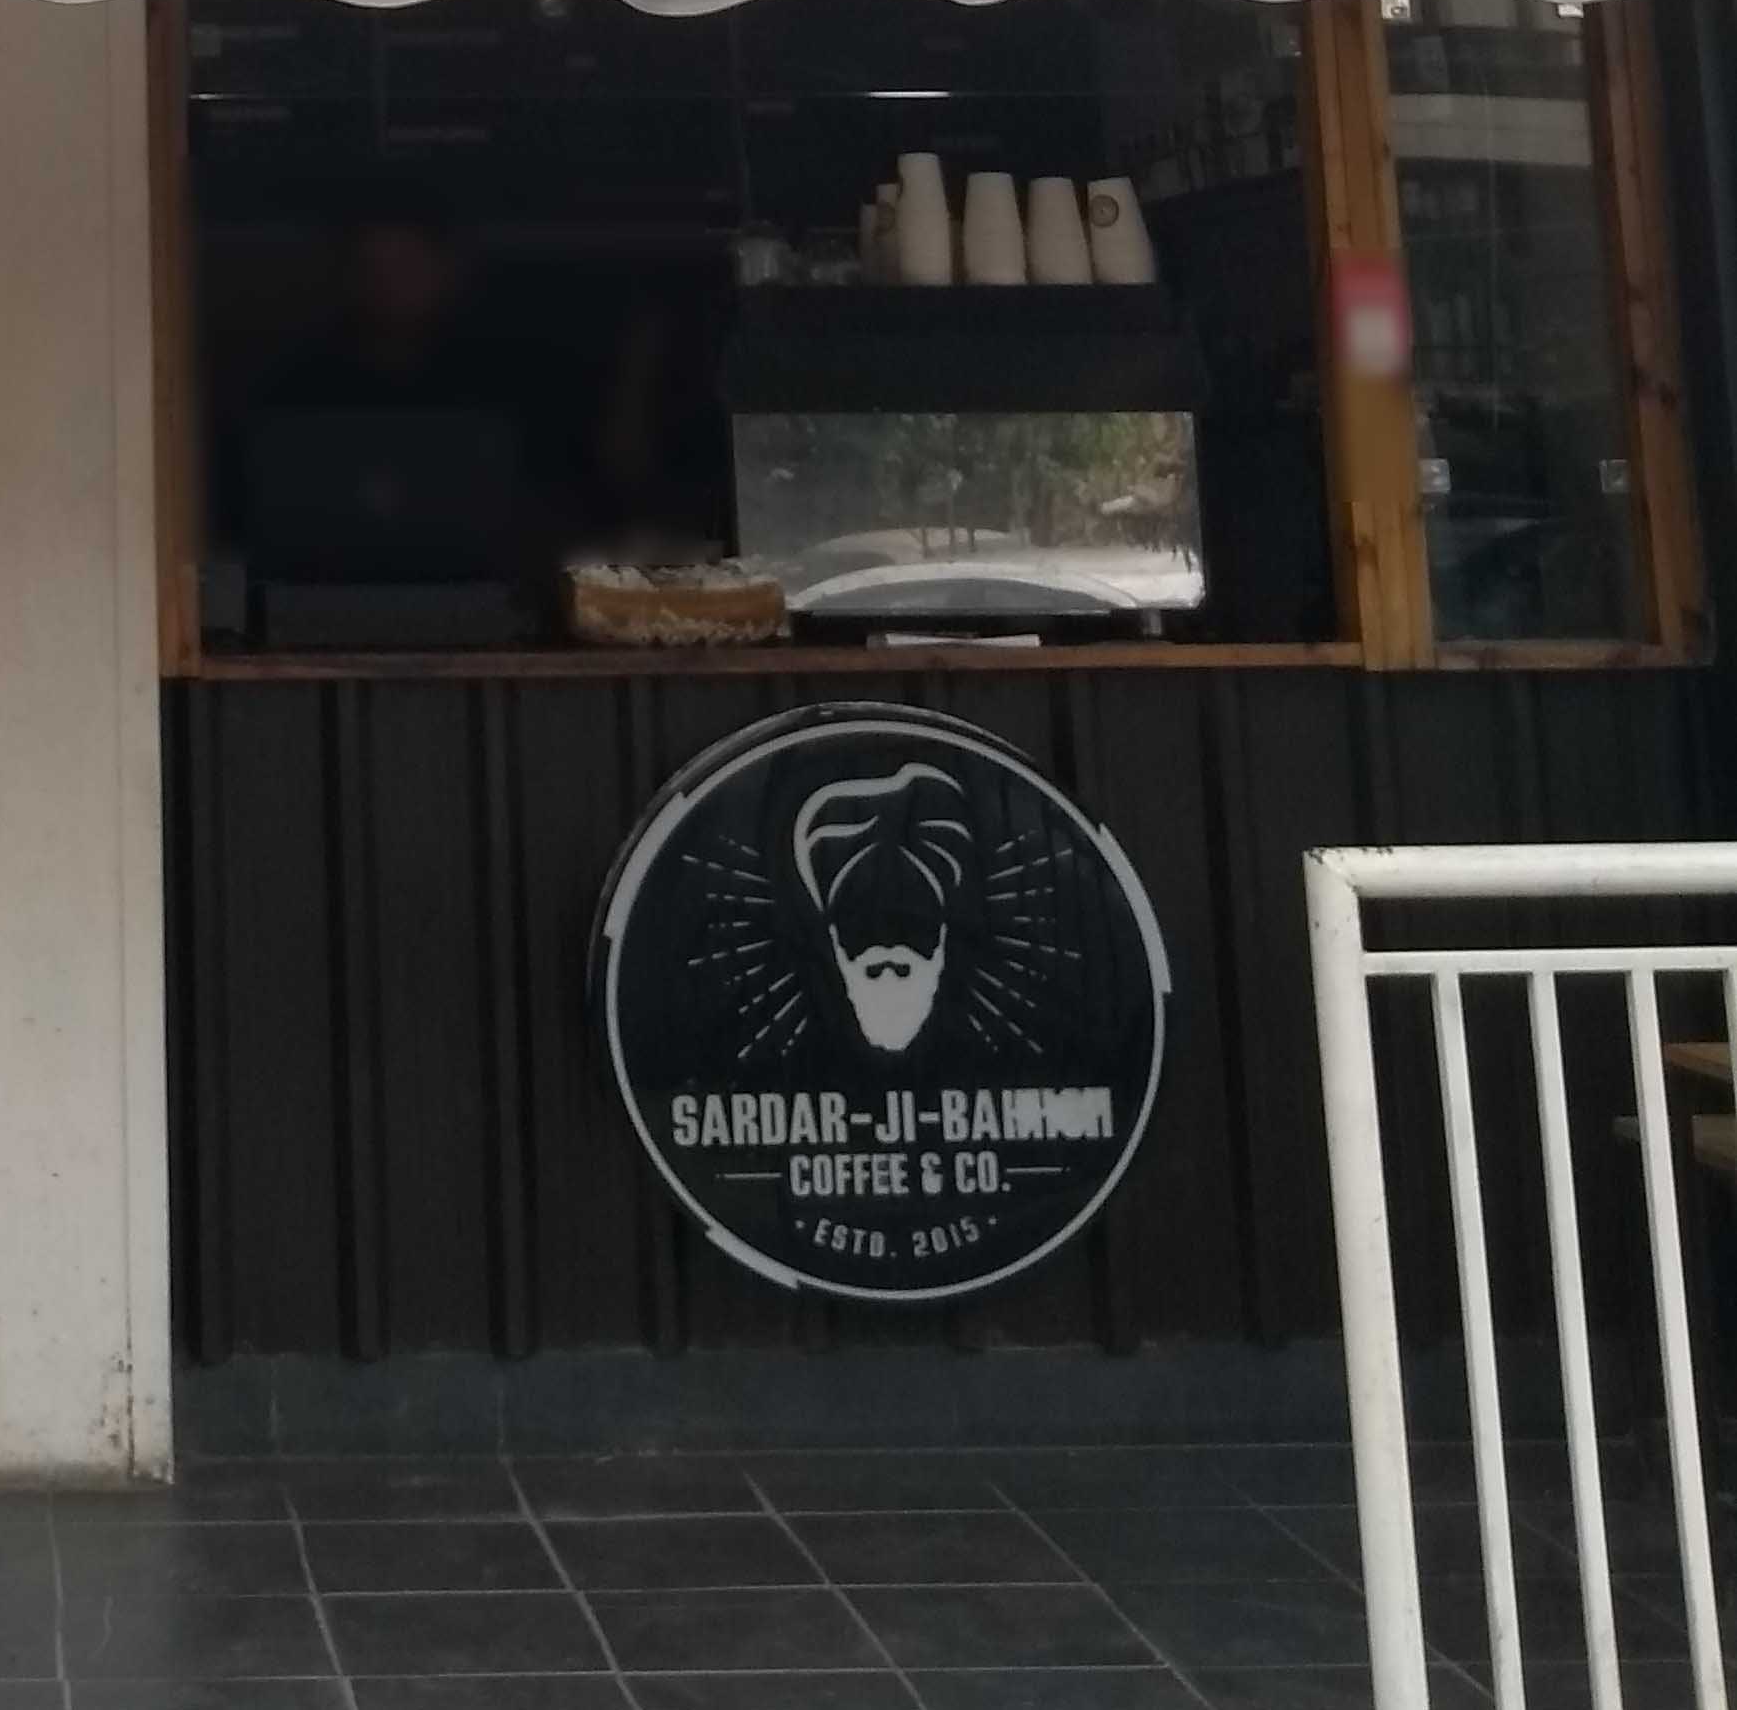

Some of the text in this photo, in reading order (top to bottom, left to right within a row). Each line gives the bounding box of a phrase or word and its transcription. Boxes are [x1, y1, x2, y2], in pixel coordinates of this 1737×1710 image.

[671, 1086, 1114, 1146] SARDAR-JI-BA
[789, 1153, 910, 1198] COFFEE
[919, 1152, 944, 1195] &
[911, 1216, 982, 1257] 2015
